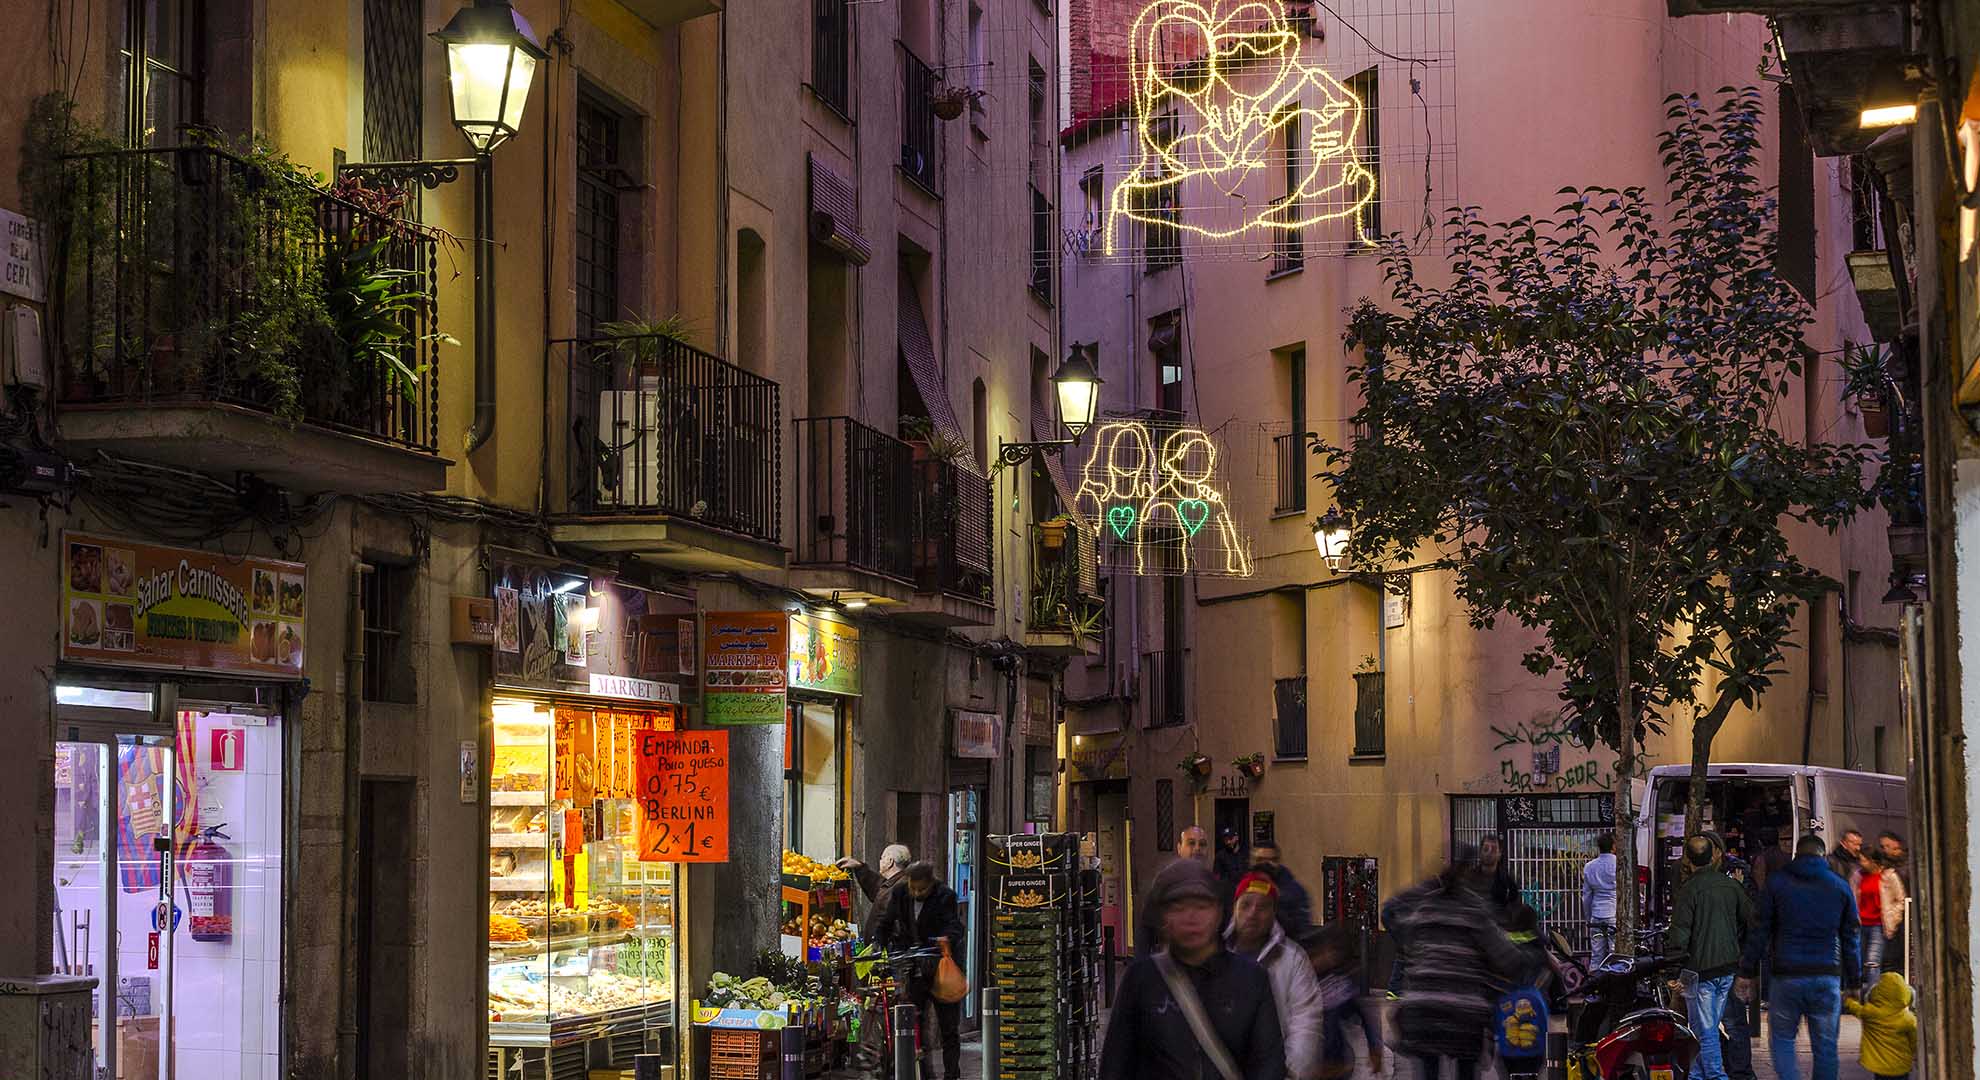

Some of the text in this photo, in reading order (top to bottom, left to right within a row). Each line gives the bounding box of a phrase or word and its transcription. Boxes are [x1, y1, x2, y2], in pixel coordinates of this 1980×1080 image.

[137, 566, 176, 619] Sahar
[706, 653, 762, 667] MARKET
[598, 677, 673, 701] MARKET PA
[1221, 775, 1246, 797] BAR
[1026, 879, 1046, 887] GINGER
